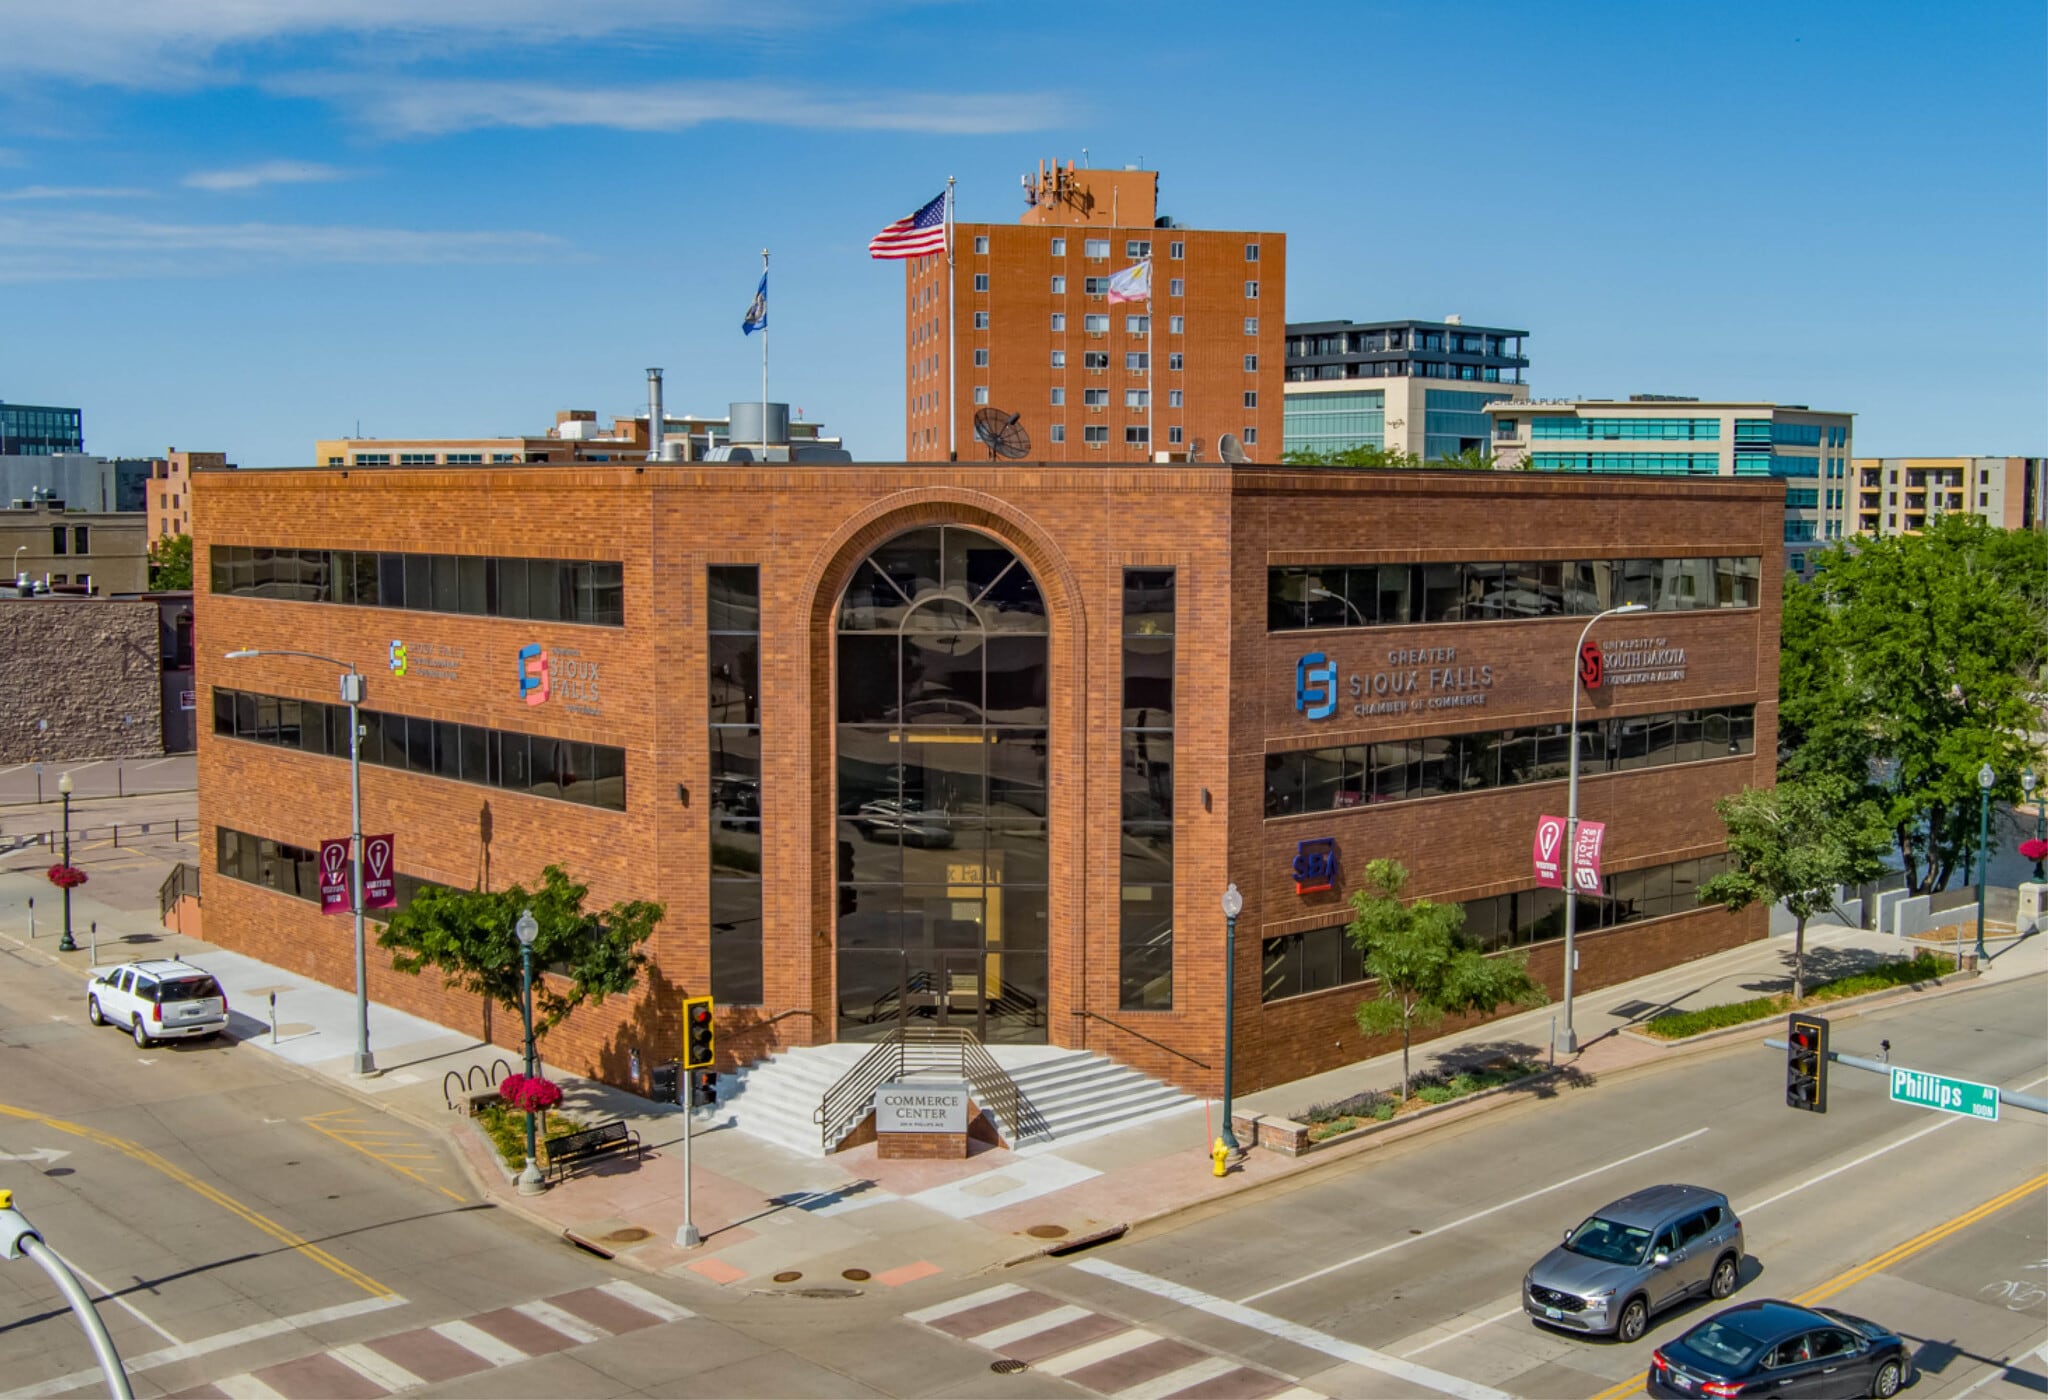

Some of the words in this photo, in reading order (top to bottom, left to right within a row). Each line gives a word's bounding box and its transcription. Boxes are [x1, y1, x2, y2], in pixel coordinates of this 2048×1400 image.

[1388, 648, 1456, 665] GREATER
[1603, 651, 1641, 668] SOUTH
[1643, 648, 1686, 665] DAKOTA
[549, 657, 599, 680] SIOUX
[551, 678, 599, 702] FALLS
[1349, 670, 1419, 696] SIOUX
[1430, 665, 1493, 690] FALLS
[1354, 701, 1408, 715] CHAMBER
[1411, 699, 1425, 710] OF
[1427, 694, 1487, 709] COMMERCE
[1894, 1071, 1963, 1107] Phillips
[1983, 1088, 1994, 1100] AV
[885, 1095, 960, 1107] COMMERCE
[896, 1108, 947, 1119] CENTER
